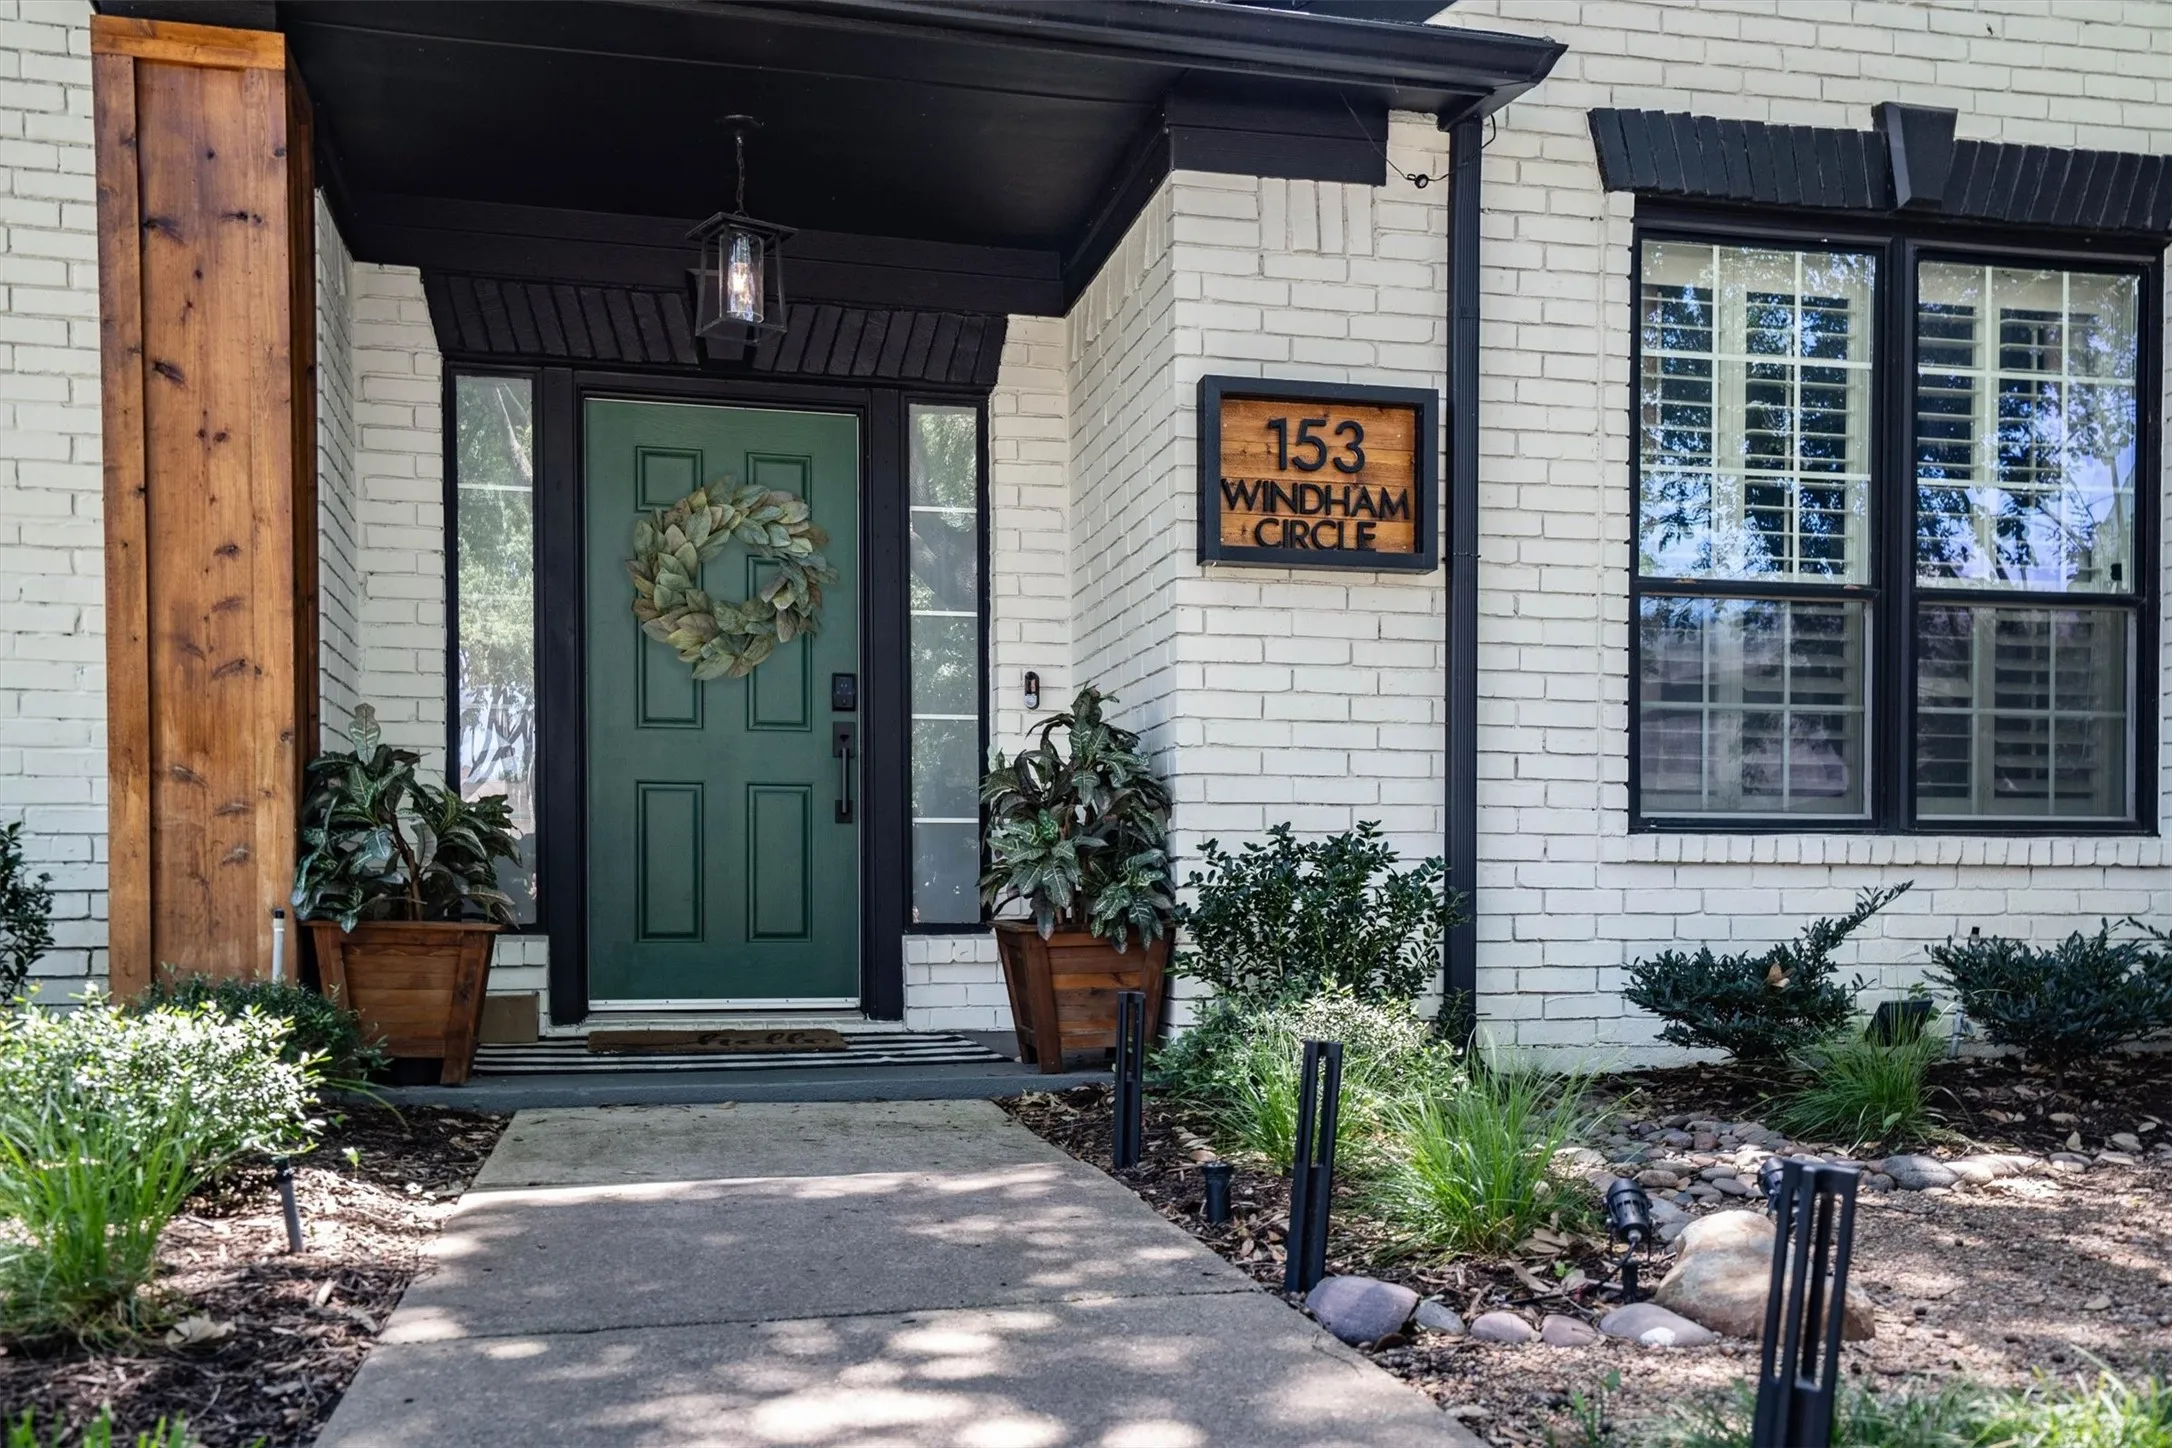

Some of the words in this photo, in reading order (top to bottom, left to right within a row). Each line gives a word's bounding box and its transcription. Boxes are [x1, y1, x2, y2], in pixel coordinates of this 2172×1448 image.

[1267, 417, 1366, 474] 153
[1220, 478, 1411, 520] WINDHAM
[1254, 517, 1377, 551] CIRCLE
